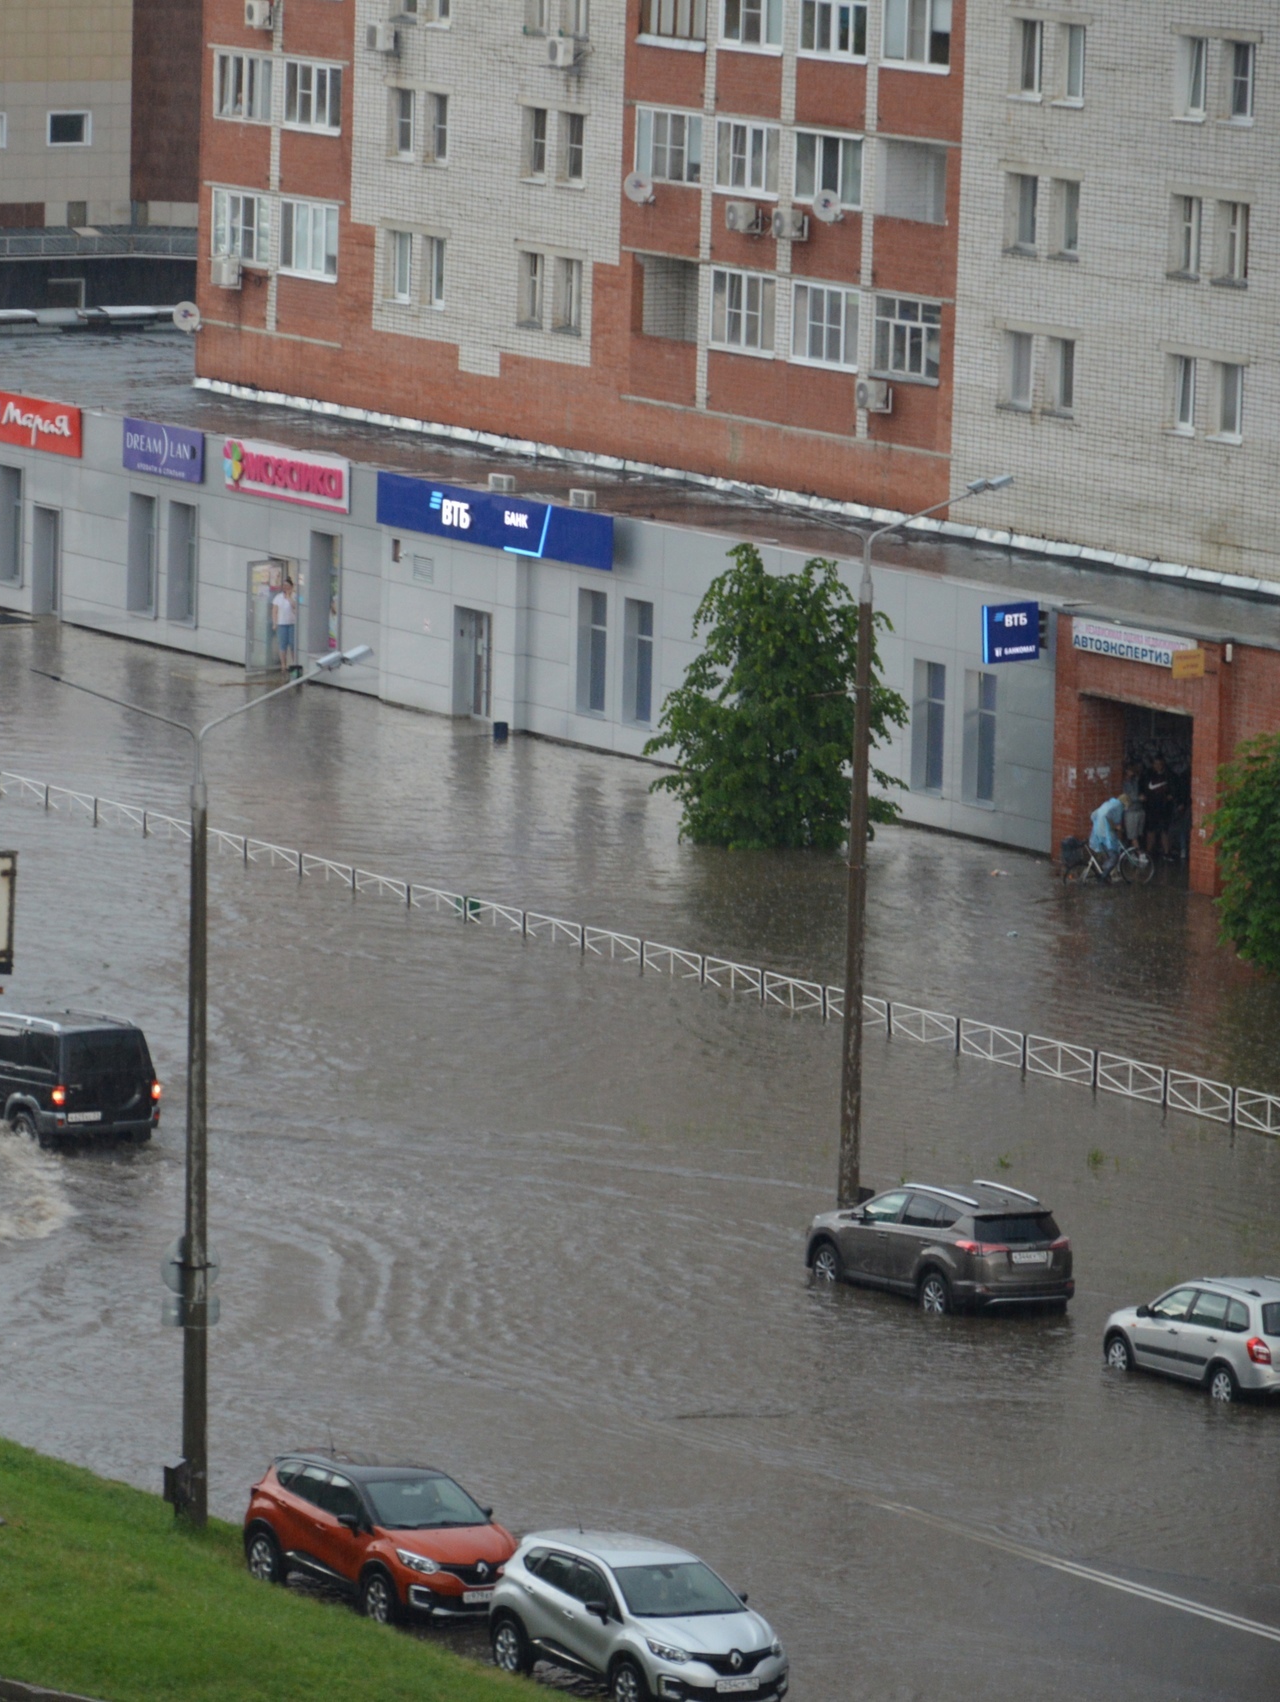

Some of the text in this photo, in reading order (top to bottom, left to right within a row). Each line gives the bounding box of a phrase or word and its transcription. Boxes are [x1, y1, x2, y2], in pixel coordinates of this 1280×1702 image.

[441, 498, 471, 529] ВТБ
[504, 510, 529, 529] БАНК
[1004, 612, 1028, 627] ВТБ
[1004, 645, 1036, 655] БАНКОМАТ
[1073, 634, 1173, 666] АВТОЭКСПЕРТИЗ
